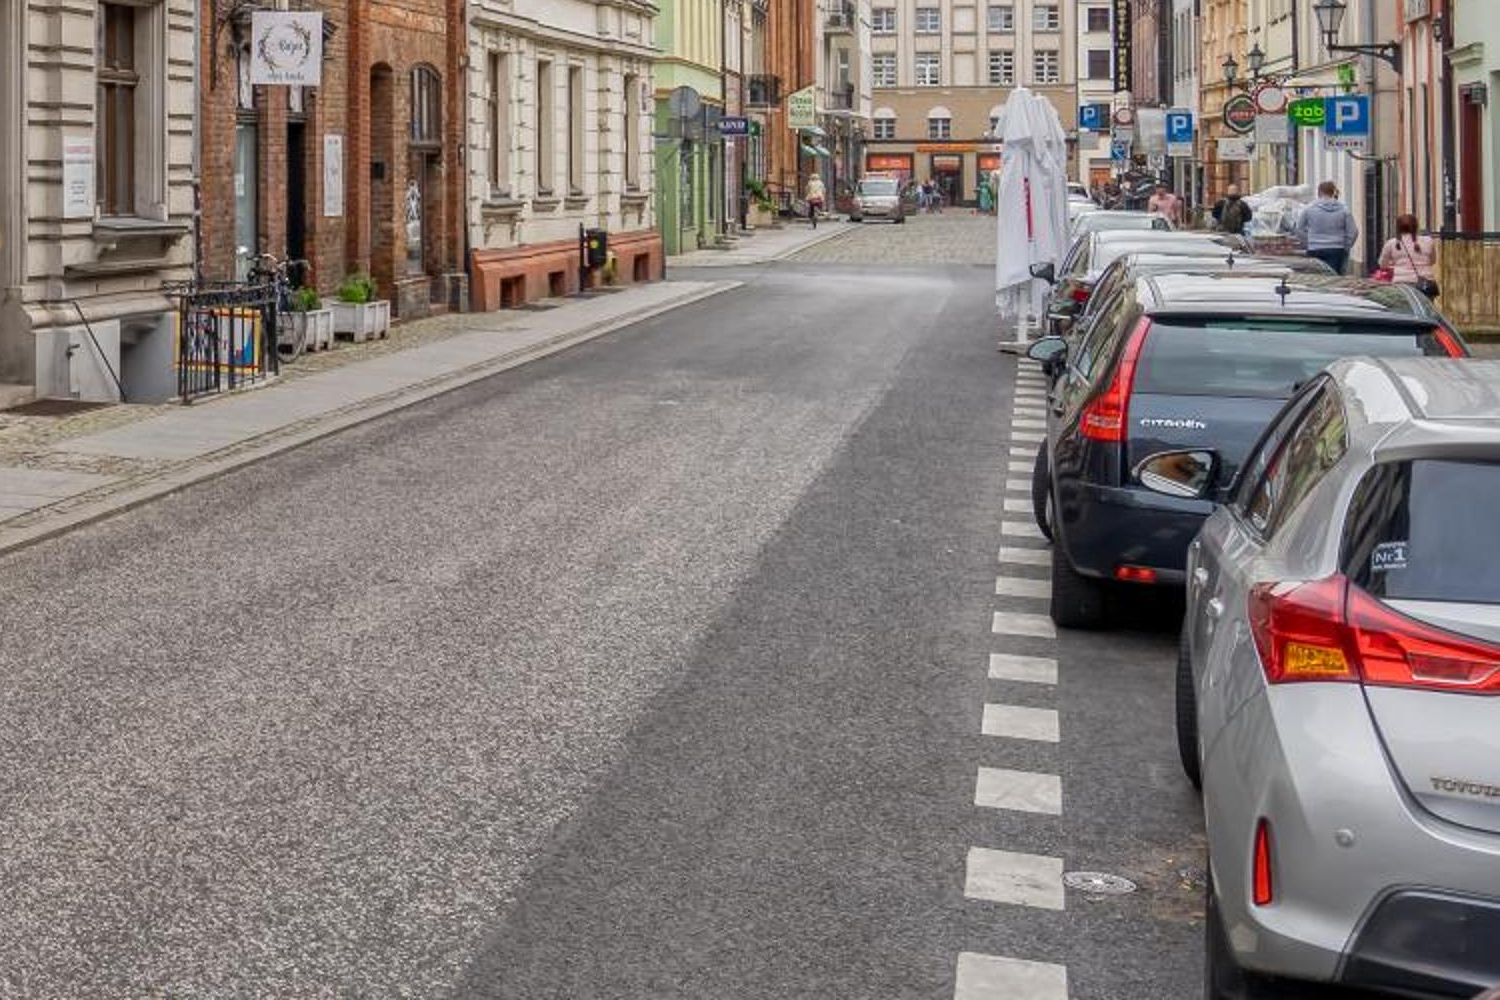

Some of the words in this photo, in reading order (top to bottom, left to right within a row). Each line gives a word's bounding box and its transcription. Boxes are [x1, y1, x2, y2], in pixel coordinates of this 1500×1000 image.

[1083, 107, 1095, 121] P
[1336, 101, 1360, 130] P
[1172, 116, 1187, 134] P
[1139, 418, 1206, 430] CITROËN
